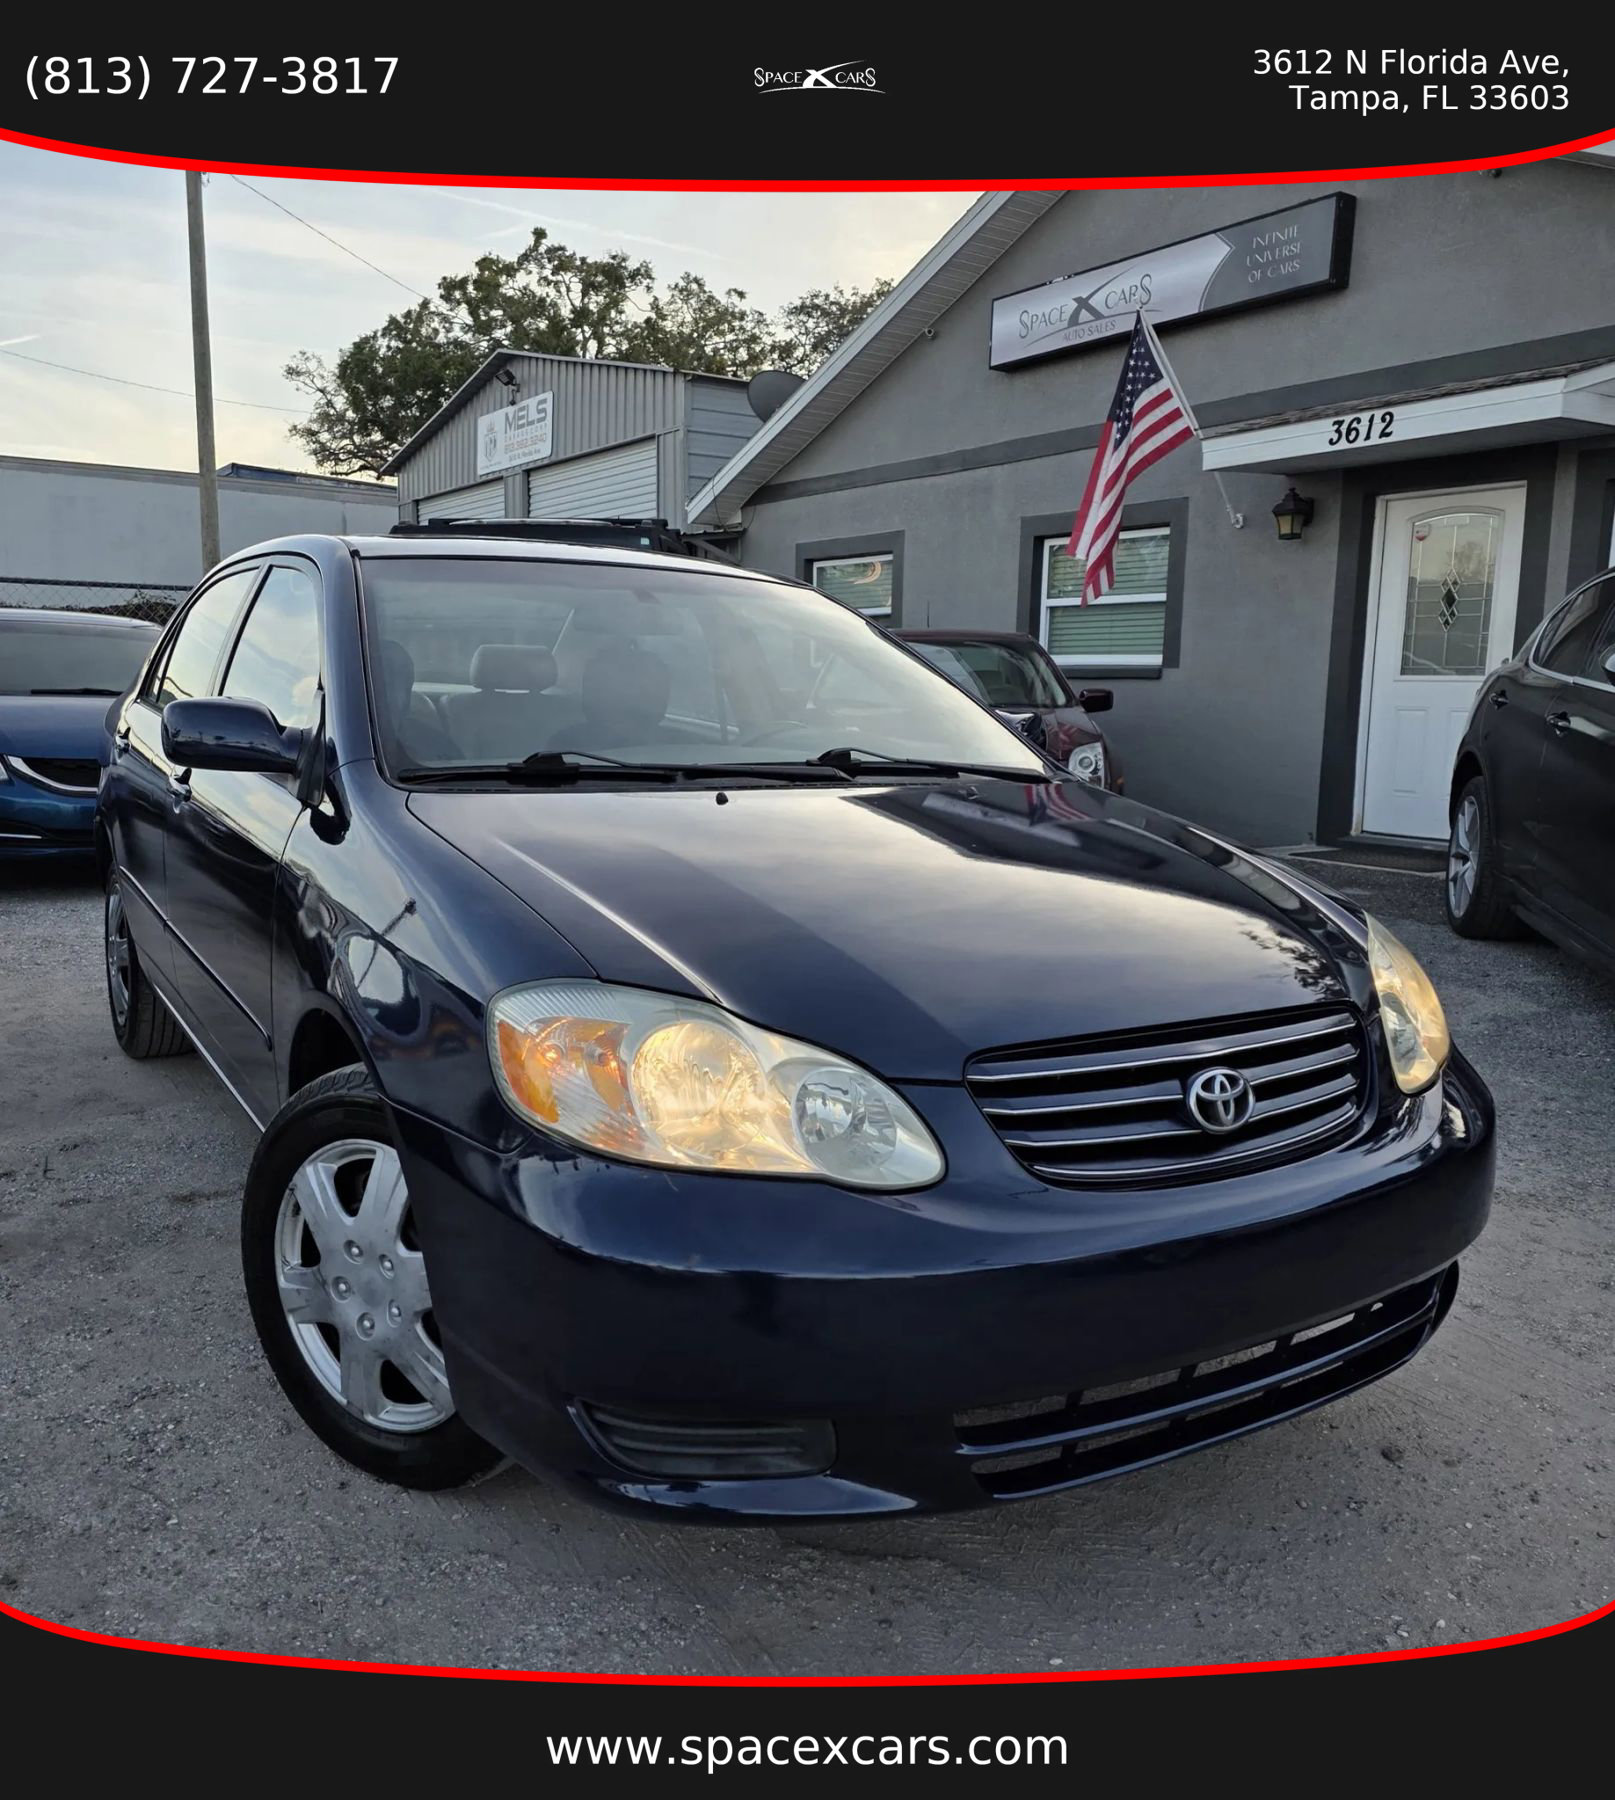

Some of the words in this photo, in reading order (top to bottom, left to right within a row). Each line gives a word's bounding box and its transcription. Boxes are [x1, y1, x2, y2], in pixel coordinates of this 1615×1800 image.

[1019, 304, 1068, 339] SPACE
[1104, 273, 1153, 310] CARS
[1063, 328, 1086, 341] AUTO
[1086, 320, 1117, 337] SALES
[504, 398, 548, 434] MELS
[1328, 411, 1395, 446] 3612
